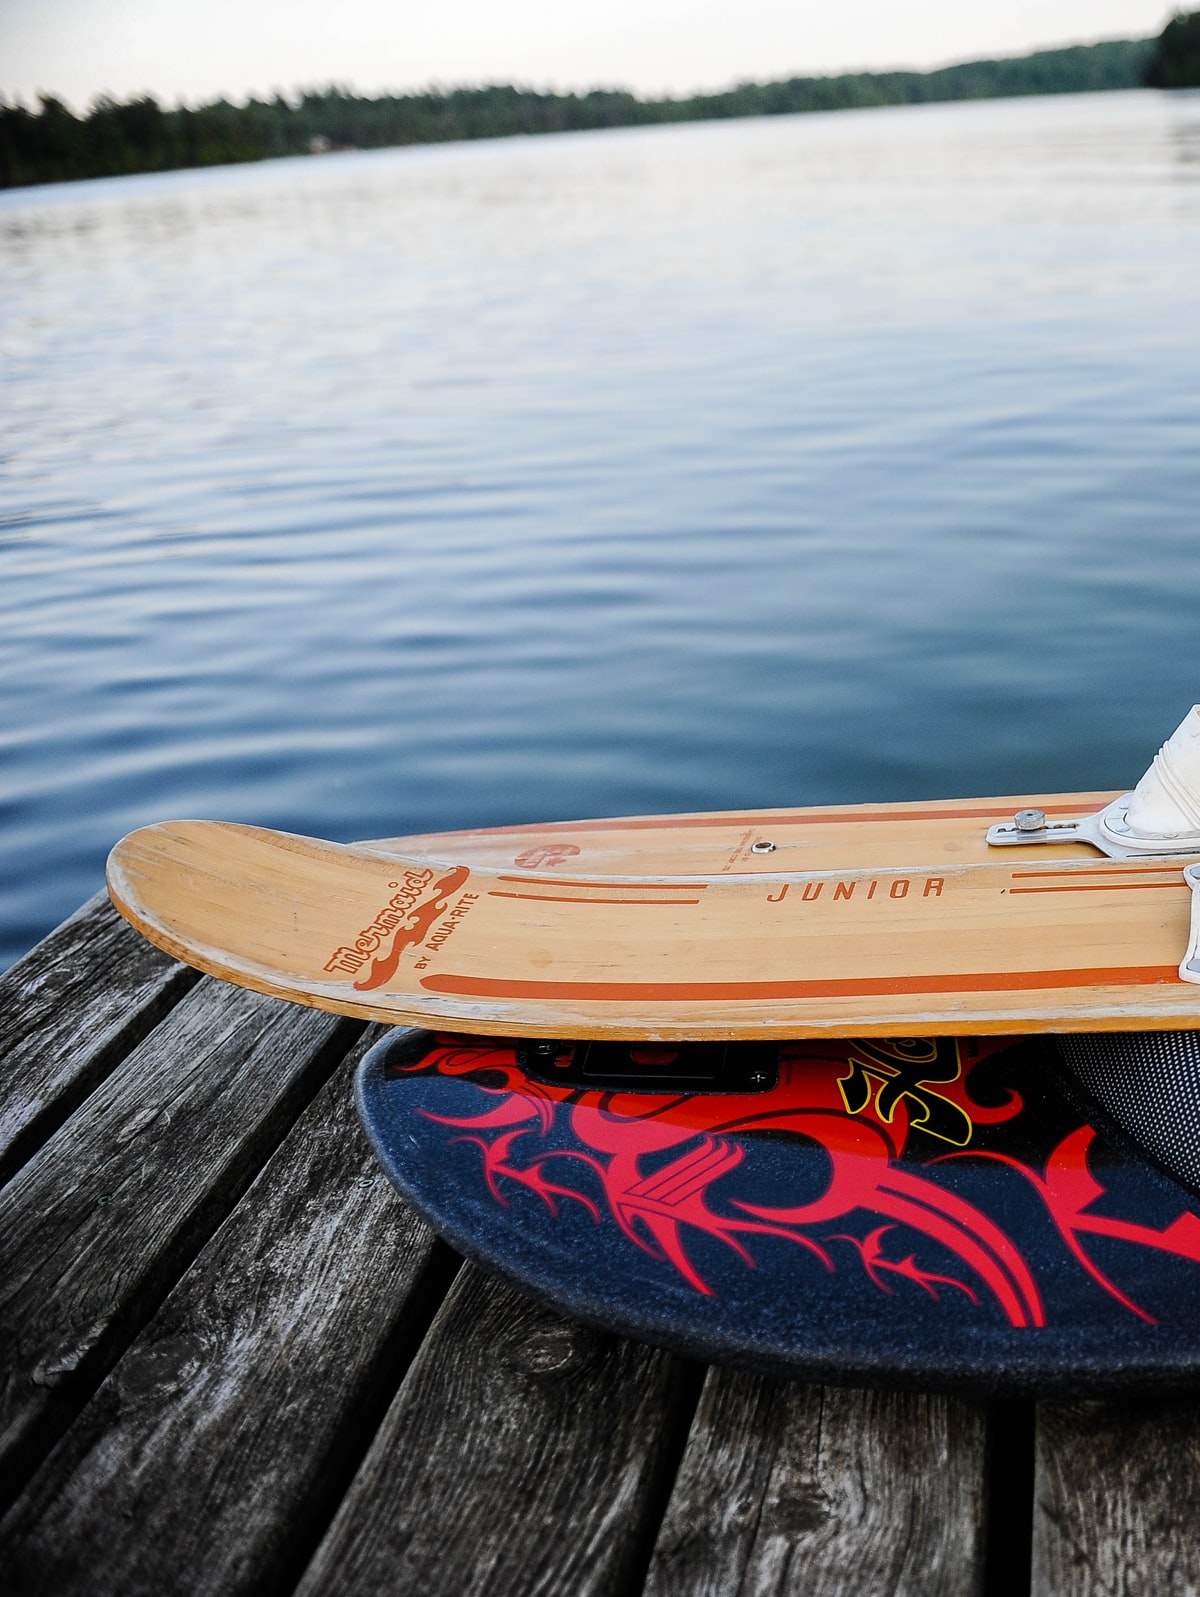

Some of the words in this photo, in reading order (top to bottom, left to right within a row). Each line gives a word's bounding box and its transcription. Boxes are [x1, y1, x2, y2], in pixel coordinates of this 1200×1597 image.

[767, 877, 944, 903] JUNIOR
[323, 868, 434, 974] Mermaid
[413, 956, 431, 970] BY
